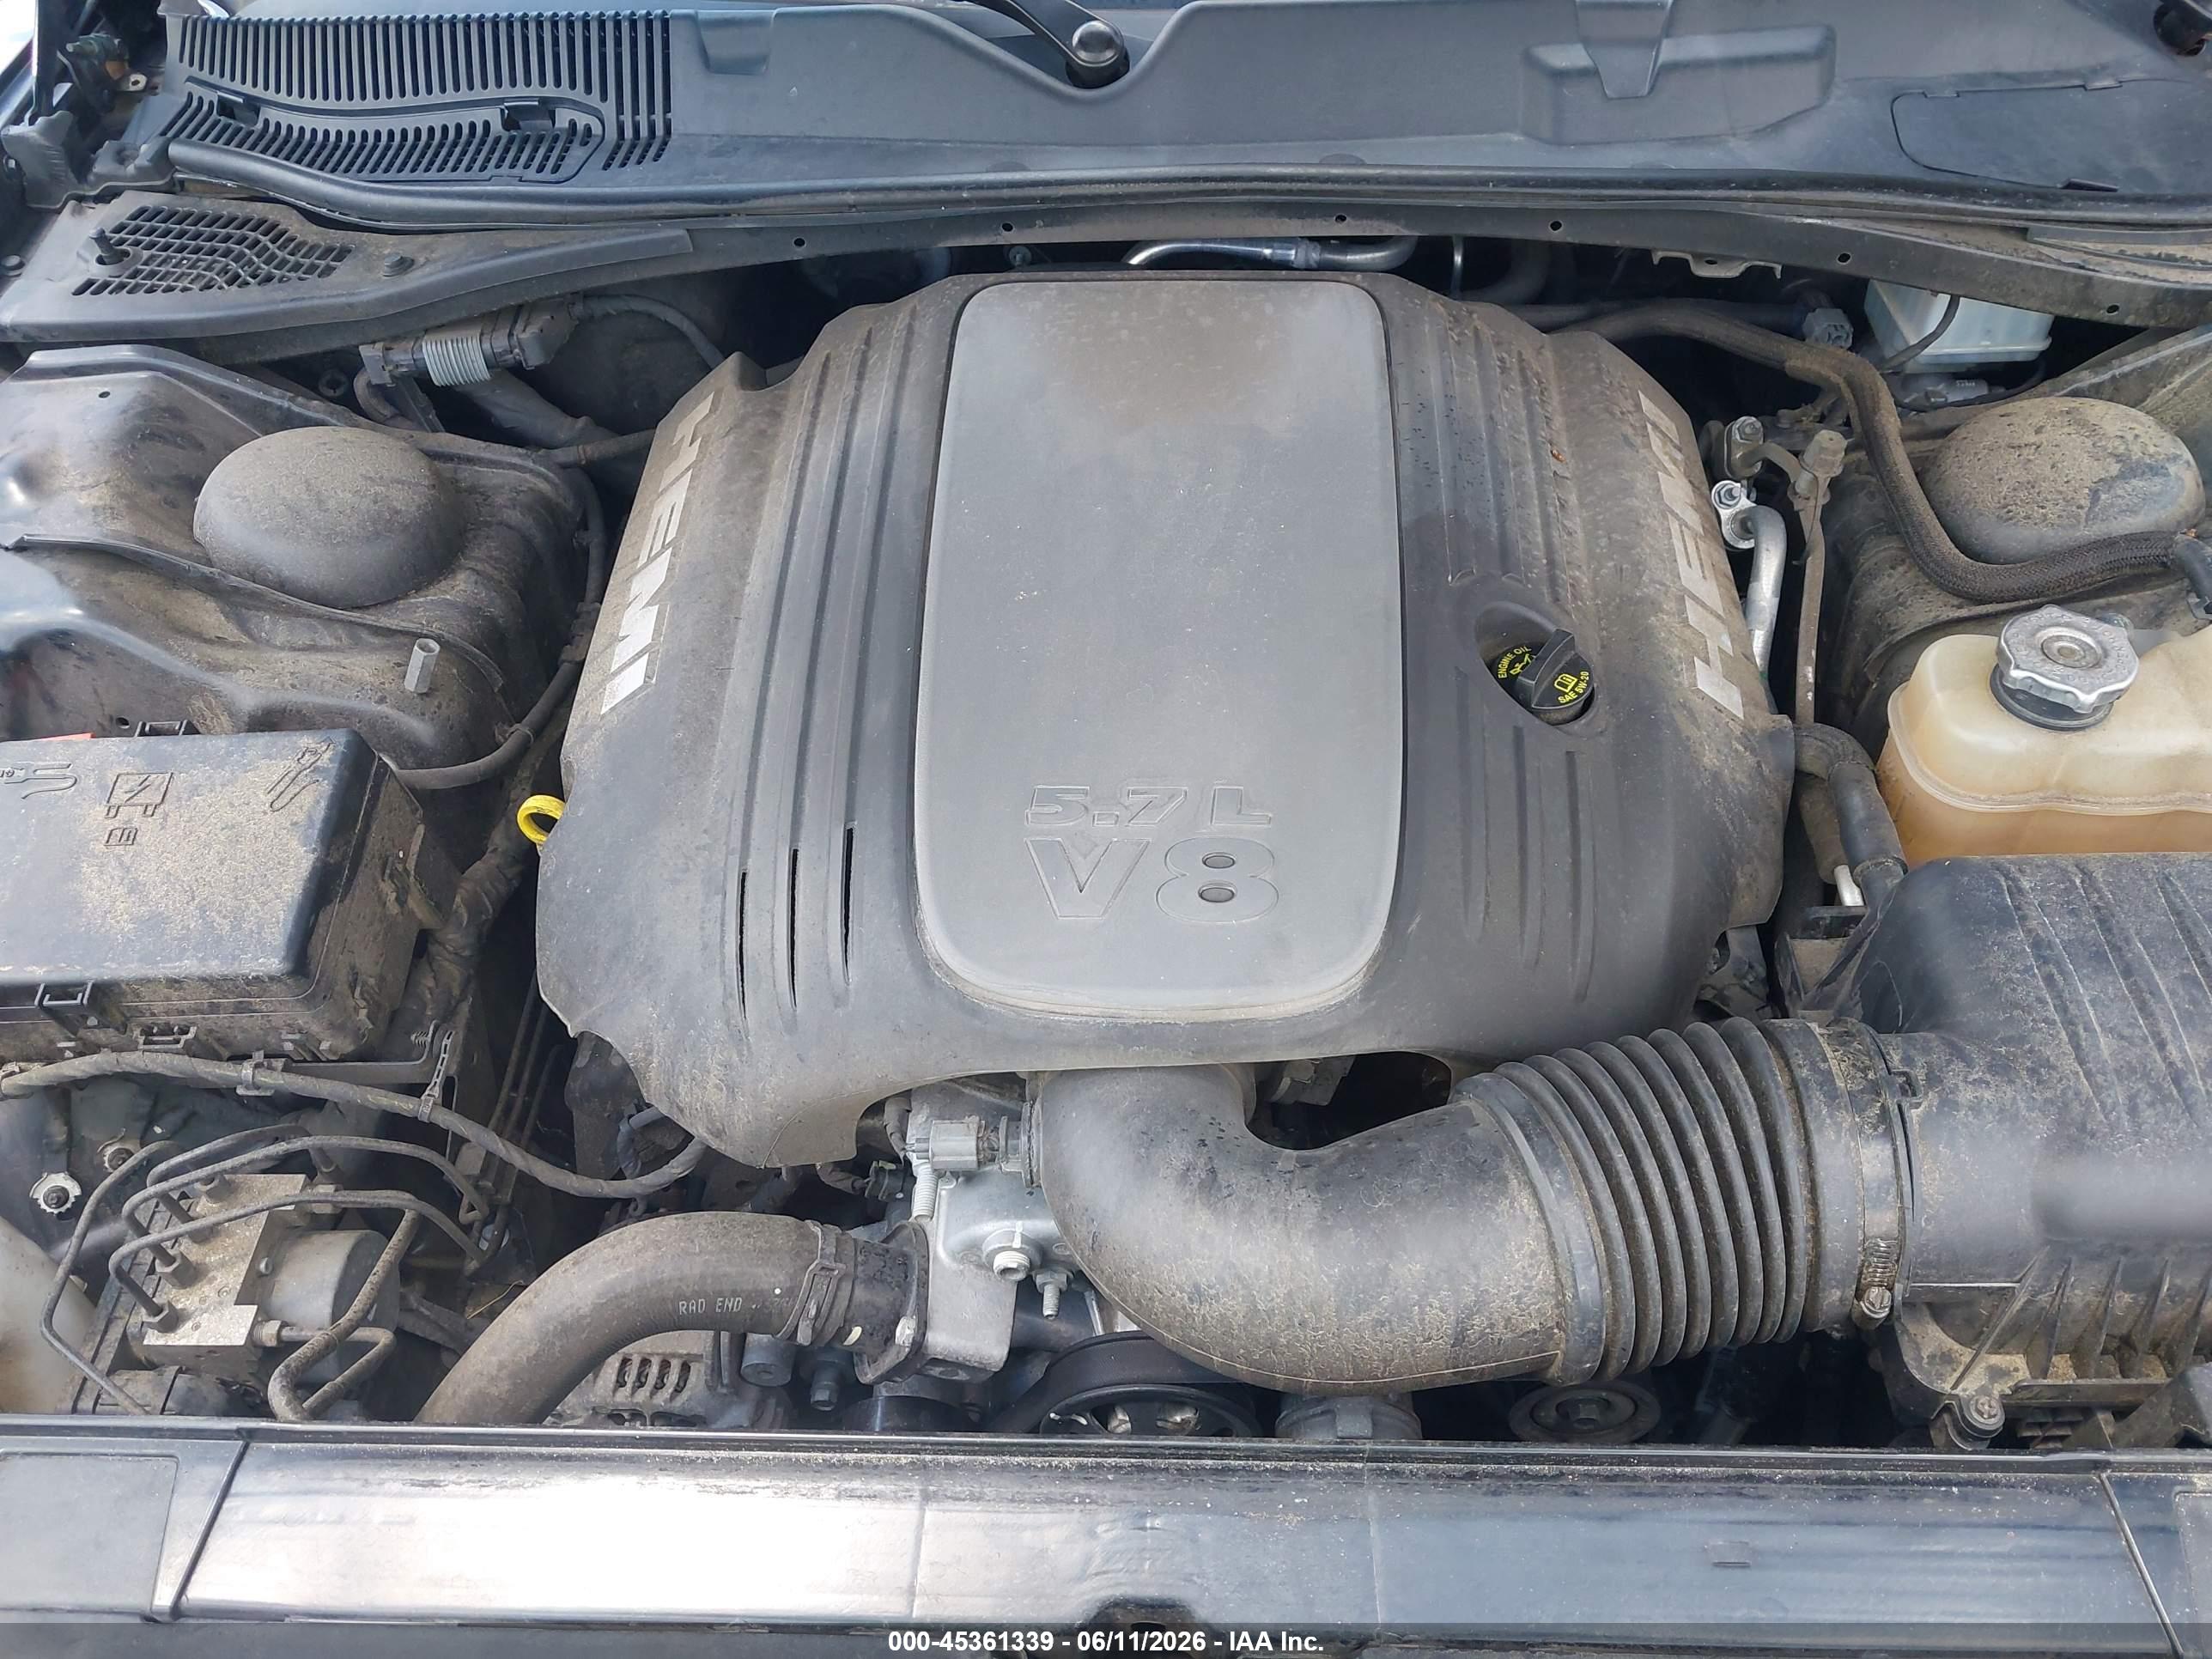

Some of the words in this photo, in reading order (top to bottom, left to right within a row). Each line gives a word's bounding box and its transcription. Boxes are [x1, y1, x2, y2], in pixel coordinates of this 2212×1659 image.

[600, 391, 715, 715] HEMI
[1638, 389, 1745, 720] HEMI
[1498, 652, 1516, 679] ENGINE
[1513, 646, 1532, 655] OIL
[1558, 691, 1578, 703] SAE
[1574, 671, 1589, 694] 5W-20
[1024, 837, 1279, 923] V8
[678, 1298, 706, 1315] RAD
[715, 1297, 742, 1312] END
